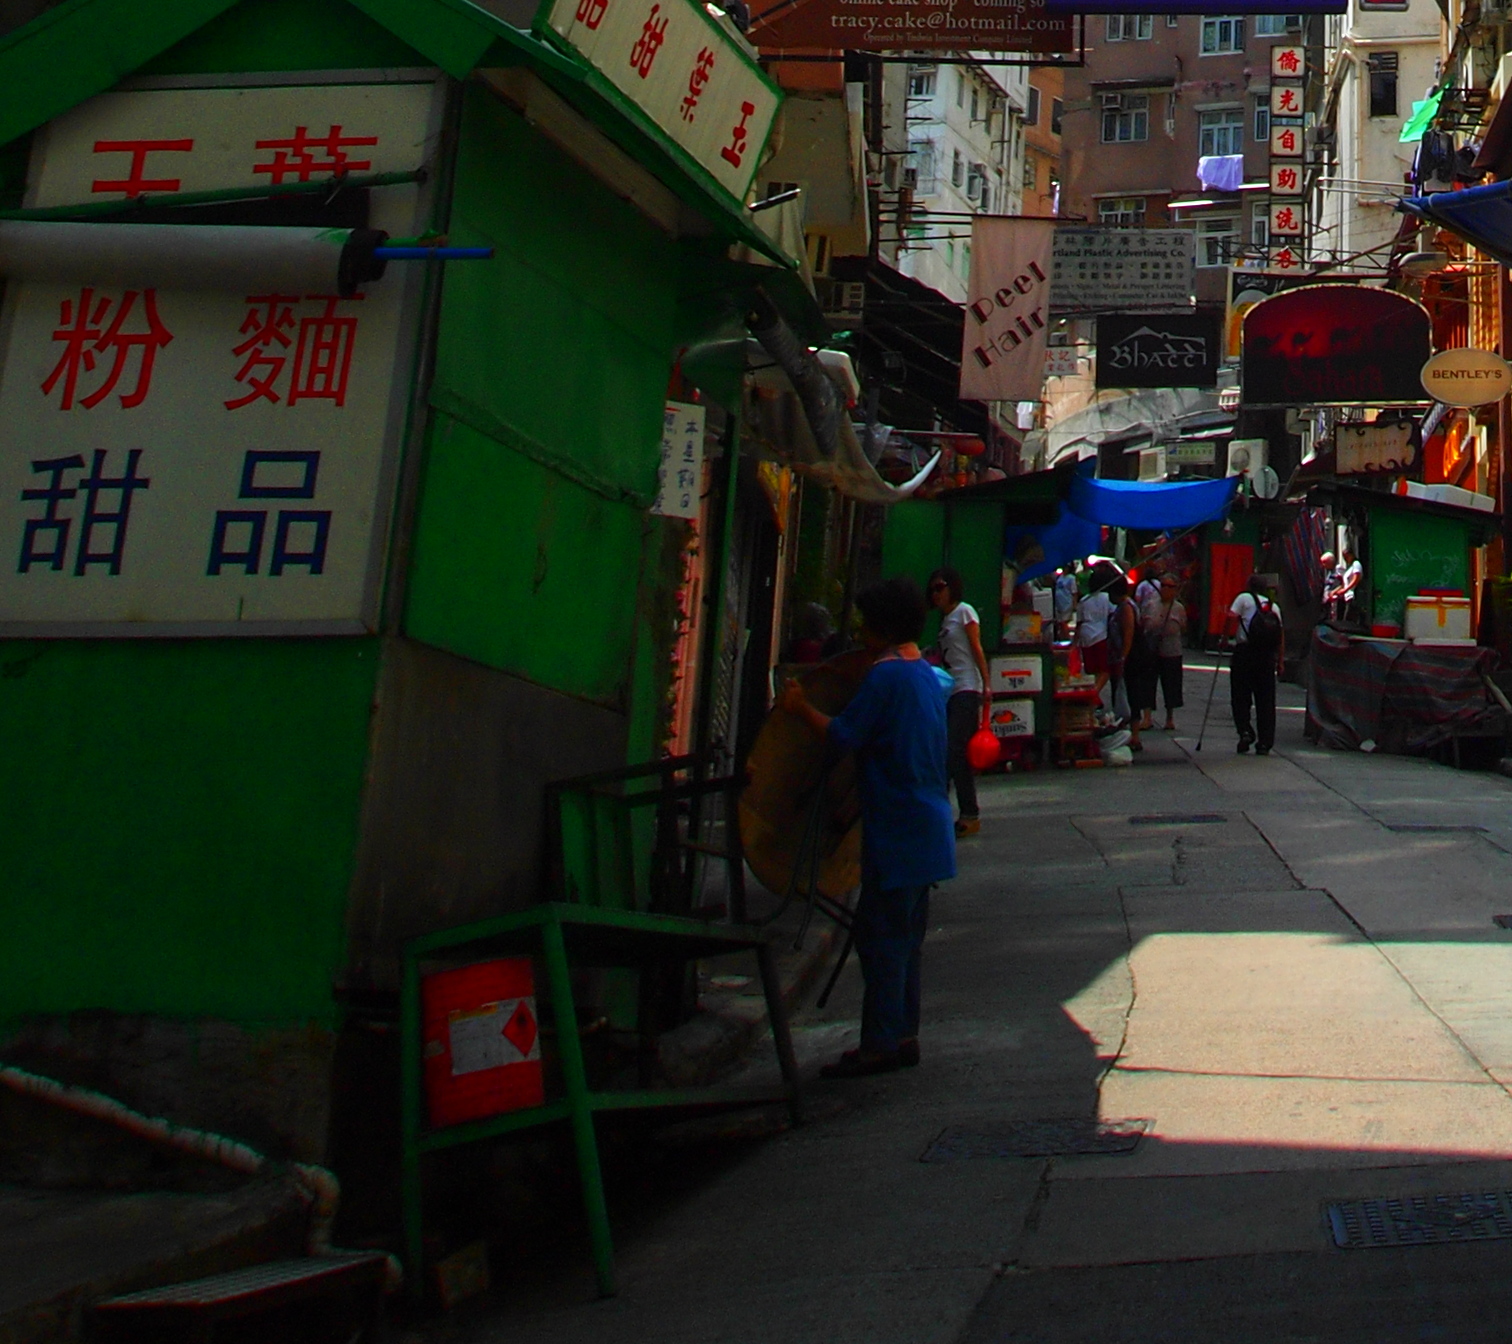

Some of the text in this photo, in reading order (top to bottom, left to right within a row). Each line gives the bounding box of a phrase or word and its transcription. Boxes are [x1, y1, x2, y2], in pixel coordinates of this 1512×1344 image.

[831, 11, 1067, 33] tracy.cake@hotmail.com
[1084, 248, 1113, 257] Plastic
[1116, 248, 1168, 259] Advertising
[1170, 249, 1186, 258] Co.
[41, 288, 365, 411] 粉麵
[974, 306, 1044, 369] Hair
[1432, 369, 1503, 380] BENTLEY'S
[16, 448, 333, 577] 甜品
